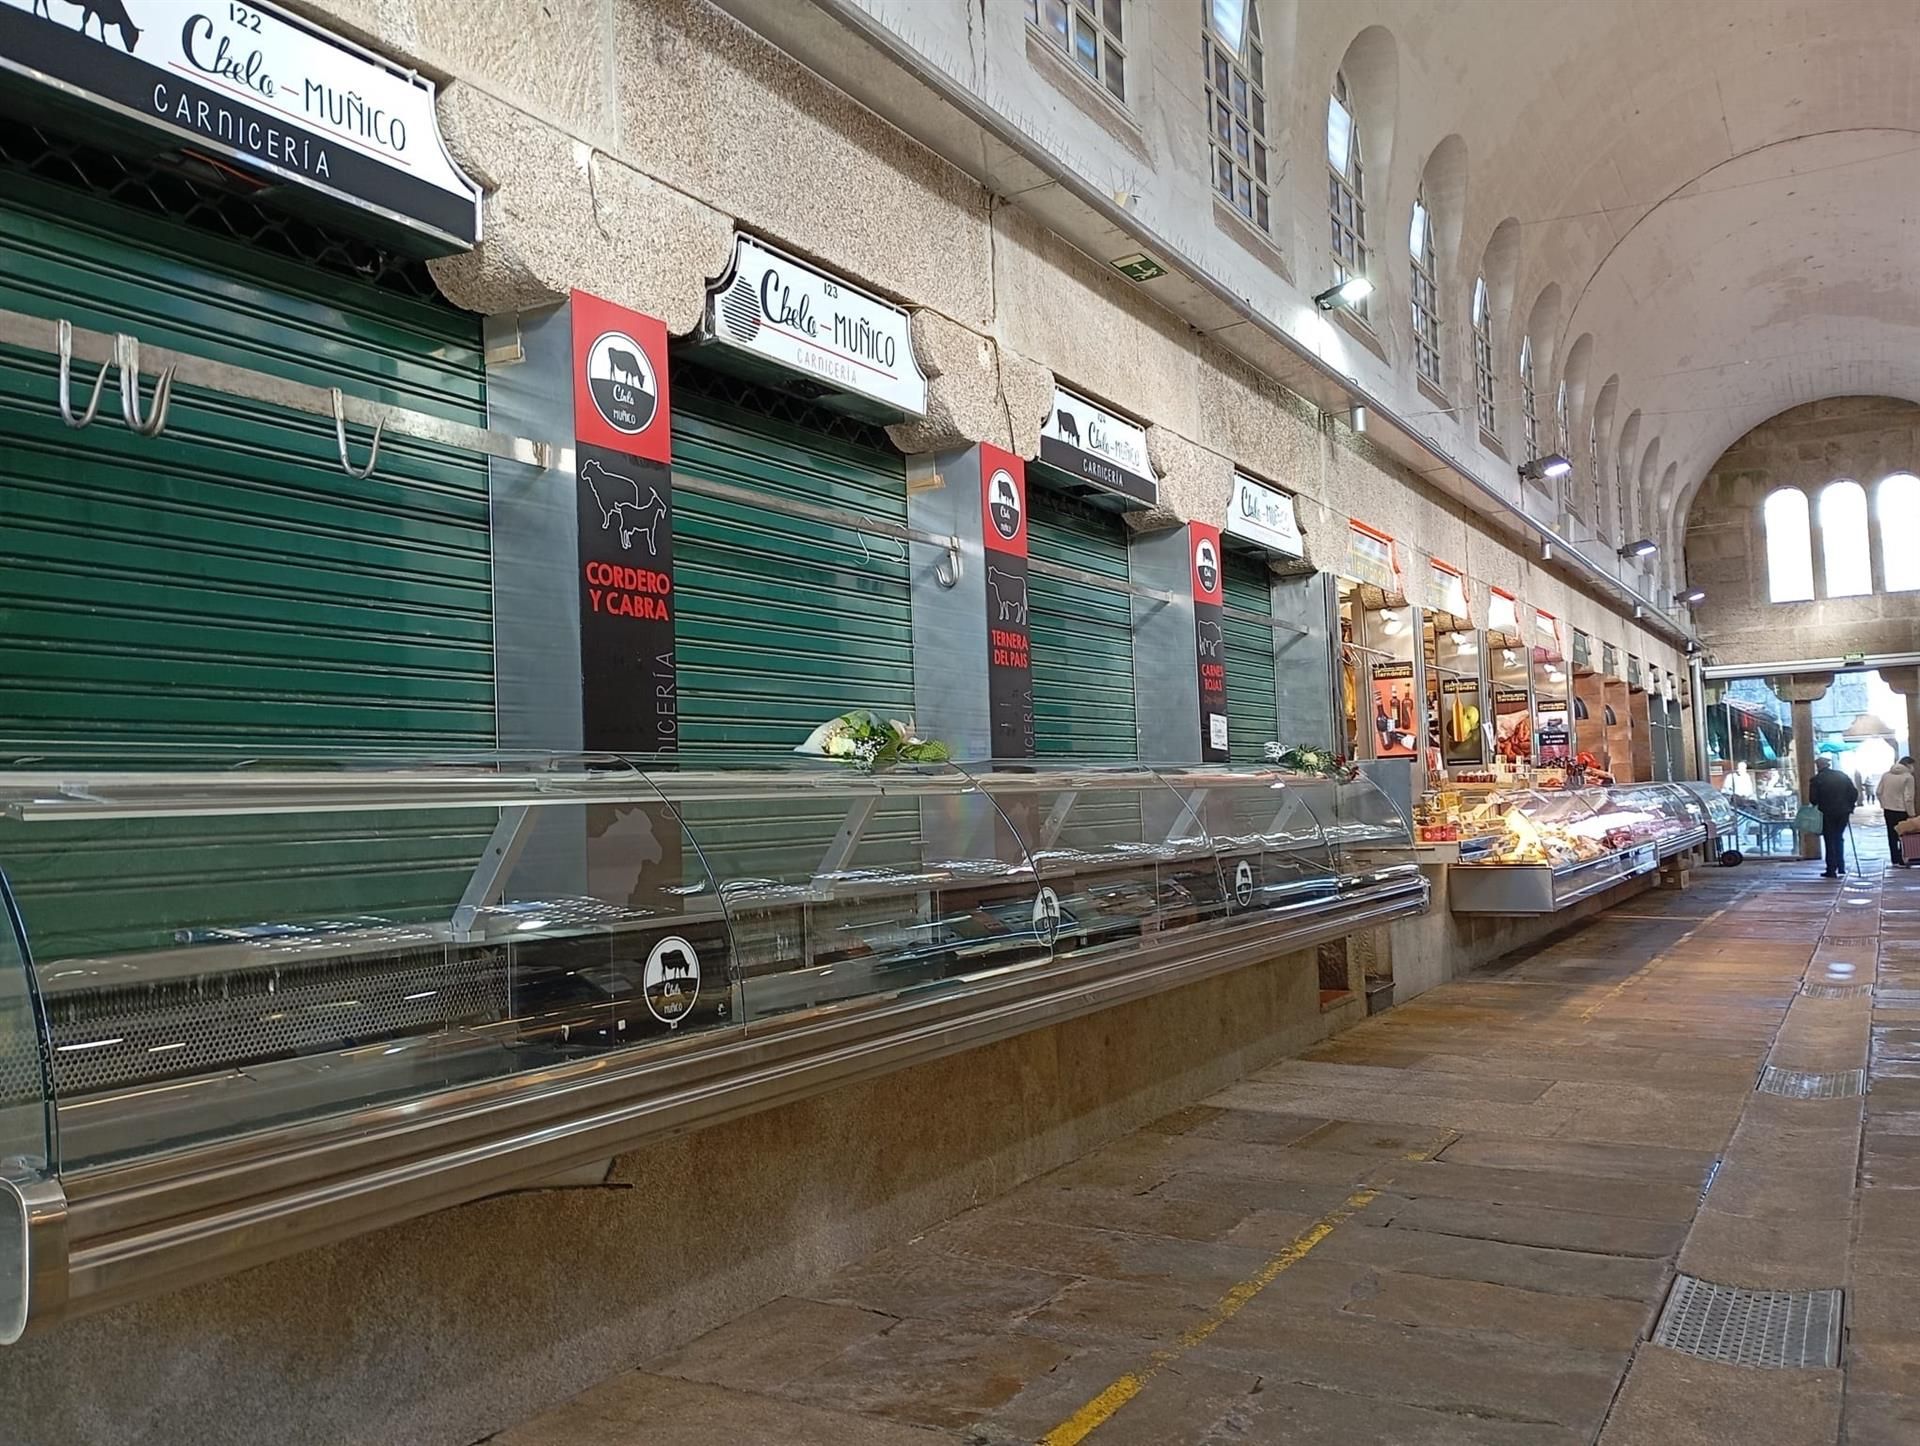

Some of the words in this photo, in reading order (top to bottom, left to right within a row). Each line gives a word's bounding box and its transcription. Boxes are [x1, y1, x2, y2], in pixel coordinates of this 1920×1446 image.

[229, 3, 262, 35] 122
[305, 77, 406, 151] MUÑICO
[154, 84, 330, 179] CARNICERÍA
[823, 282, 839, 299] 123
[834, 311, 896, 368] MUÑICO
[797, 347, 857, 383] CARNICERÍA
[585, 561, 670, 595] CORDERO
[589, 588, 602, 613] Y
[606, 591, 669, 622] CABRA
[991, 629, 1029, 651] TERNERA
[994, 650, 1010, 666] DEL
